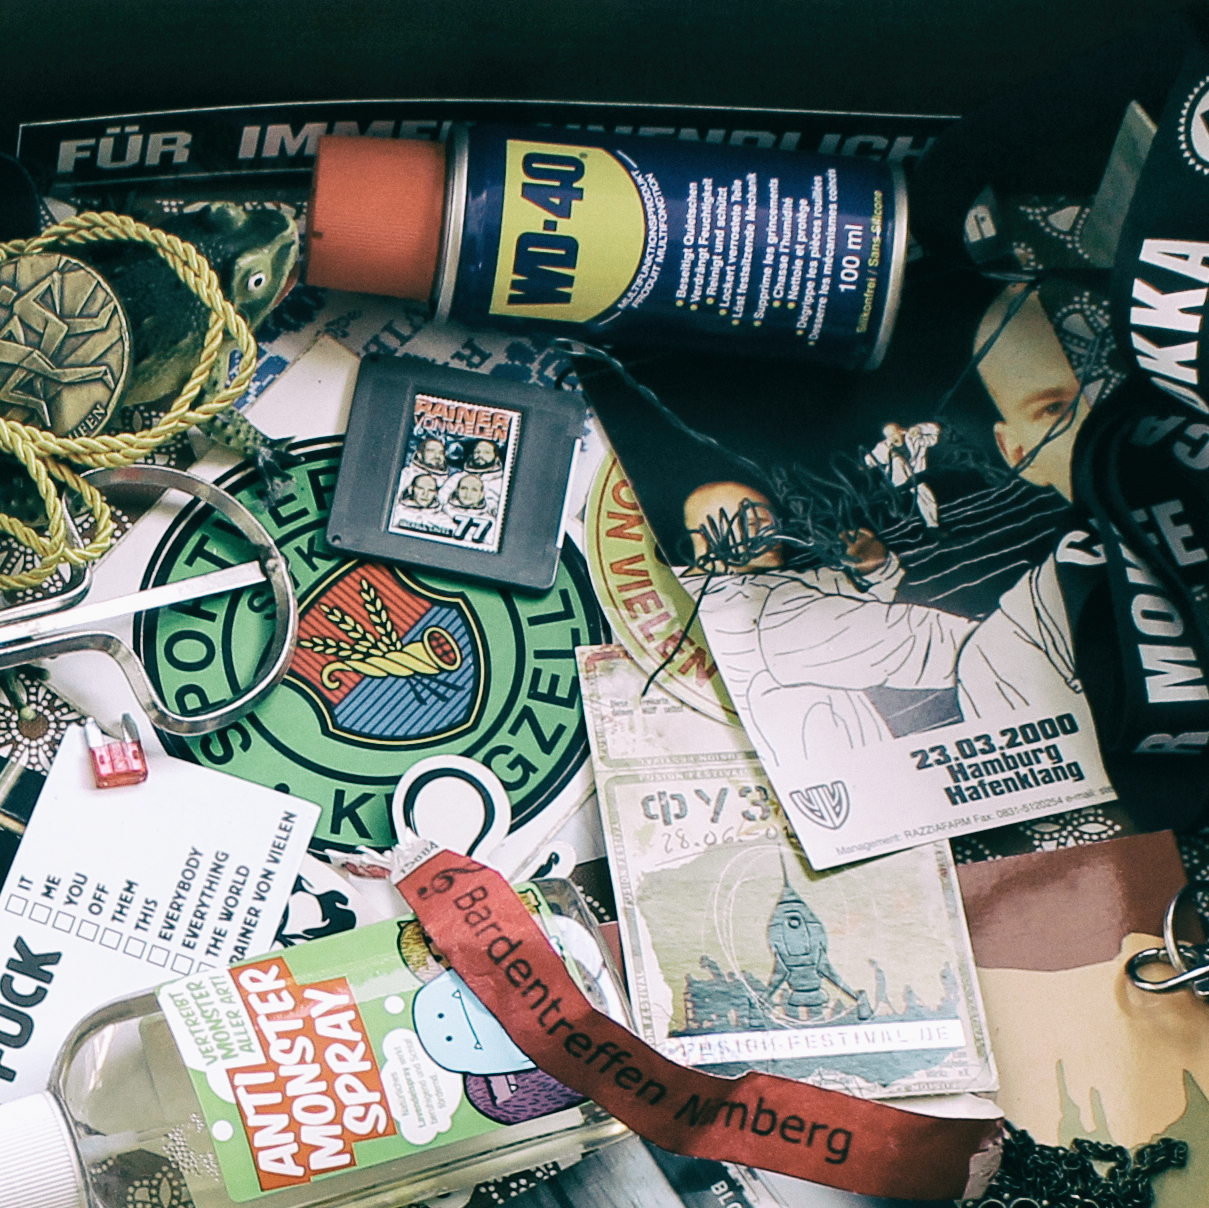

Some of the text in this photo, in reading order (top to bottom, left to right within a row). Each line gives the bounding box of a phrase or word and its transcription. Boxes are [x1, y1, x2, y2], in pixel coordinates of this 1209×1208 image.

[56, 124, 193, 174] FÜR
[504, 149, 587, 312] WD-40
[617, 168, 662, 311] MULTIFUNKTIONSPRODUKT
[632, 172, 670, 309] PRODUIT MULTIFONCTION
[675, 182, 698, 298] Beseitigt Quietschen
[690, 178, 714, 302] Verdrängt Feuchtigkeit
[706, 186, 727, 295] Reinigt und schützt
[719, 179, 743, 307] Lockert verrostete Teile
[732, 172, 757, 317] Löst festsitzende Mechanik
[753, 177, 781, 319] Supprime les grincements
[794, 198, 810, 242] protège
[808, 219, 823, 258] pièces
[772, 254, 788, 298] Chasse
[787, 258, 803, 300] Nettoie
[806, 260, 818, 278] les
[818, 277, 831, 294] les
[838, 223, 863, 293] 100 ml
[856, 276, 876, 333] Silikonfrei
[414, 398, 512, 430] RAINER
[450, 513, 493, 544] 77
[909, 711, 1081, 772] 23.03.2000
[946, 740, 1064, 787] Hamburg
[943, 757, 1087, 807] Hafenklang
[17, 874, 34, 892] IT
[40, 873, 63, 901] ME
[64, 872, 89, 909] YOU
[88, 882, 110, 917] OFF
[111, 880, 139, 924] THEM
[134, 898, 158, 933] THIS
[158, 845, 206, 944] EVERYBODY
[182, 850, 230, 951] EVERYTHING
[205, 863, 251, 959] THE WORLD
[229, 810, 297, 964] RAINER VON VIELEN
[188, 981, 239, 1060] MONSTER
[452, 882, 667, 1106] Bardentreffen
[170, 991, 217, 1067] VERTREIBT
[222, 1010, 255, 1055] ALLER
[245, 964, 351, 1172] MONSTER
[309, 987, 391, 1140] SPRAY
[238, 1069, 307, 1181] ANTI
